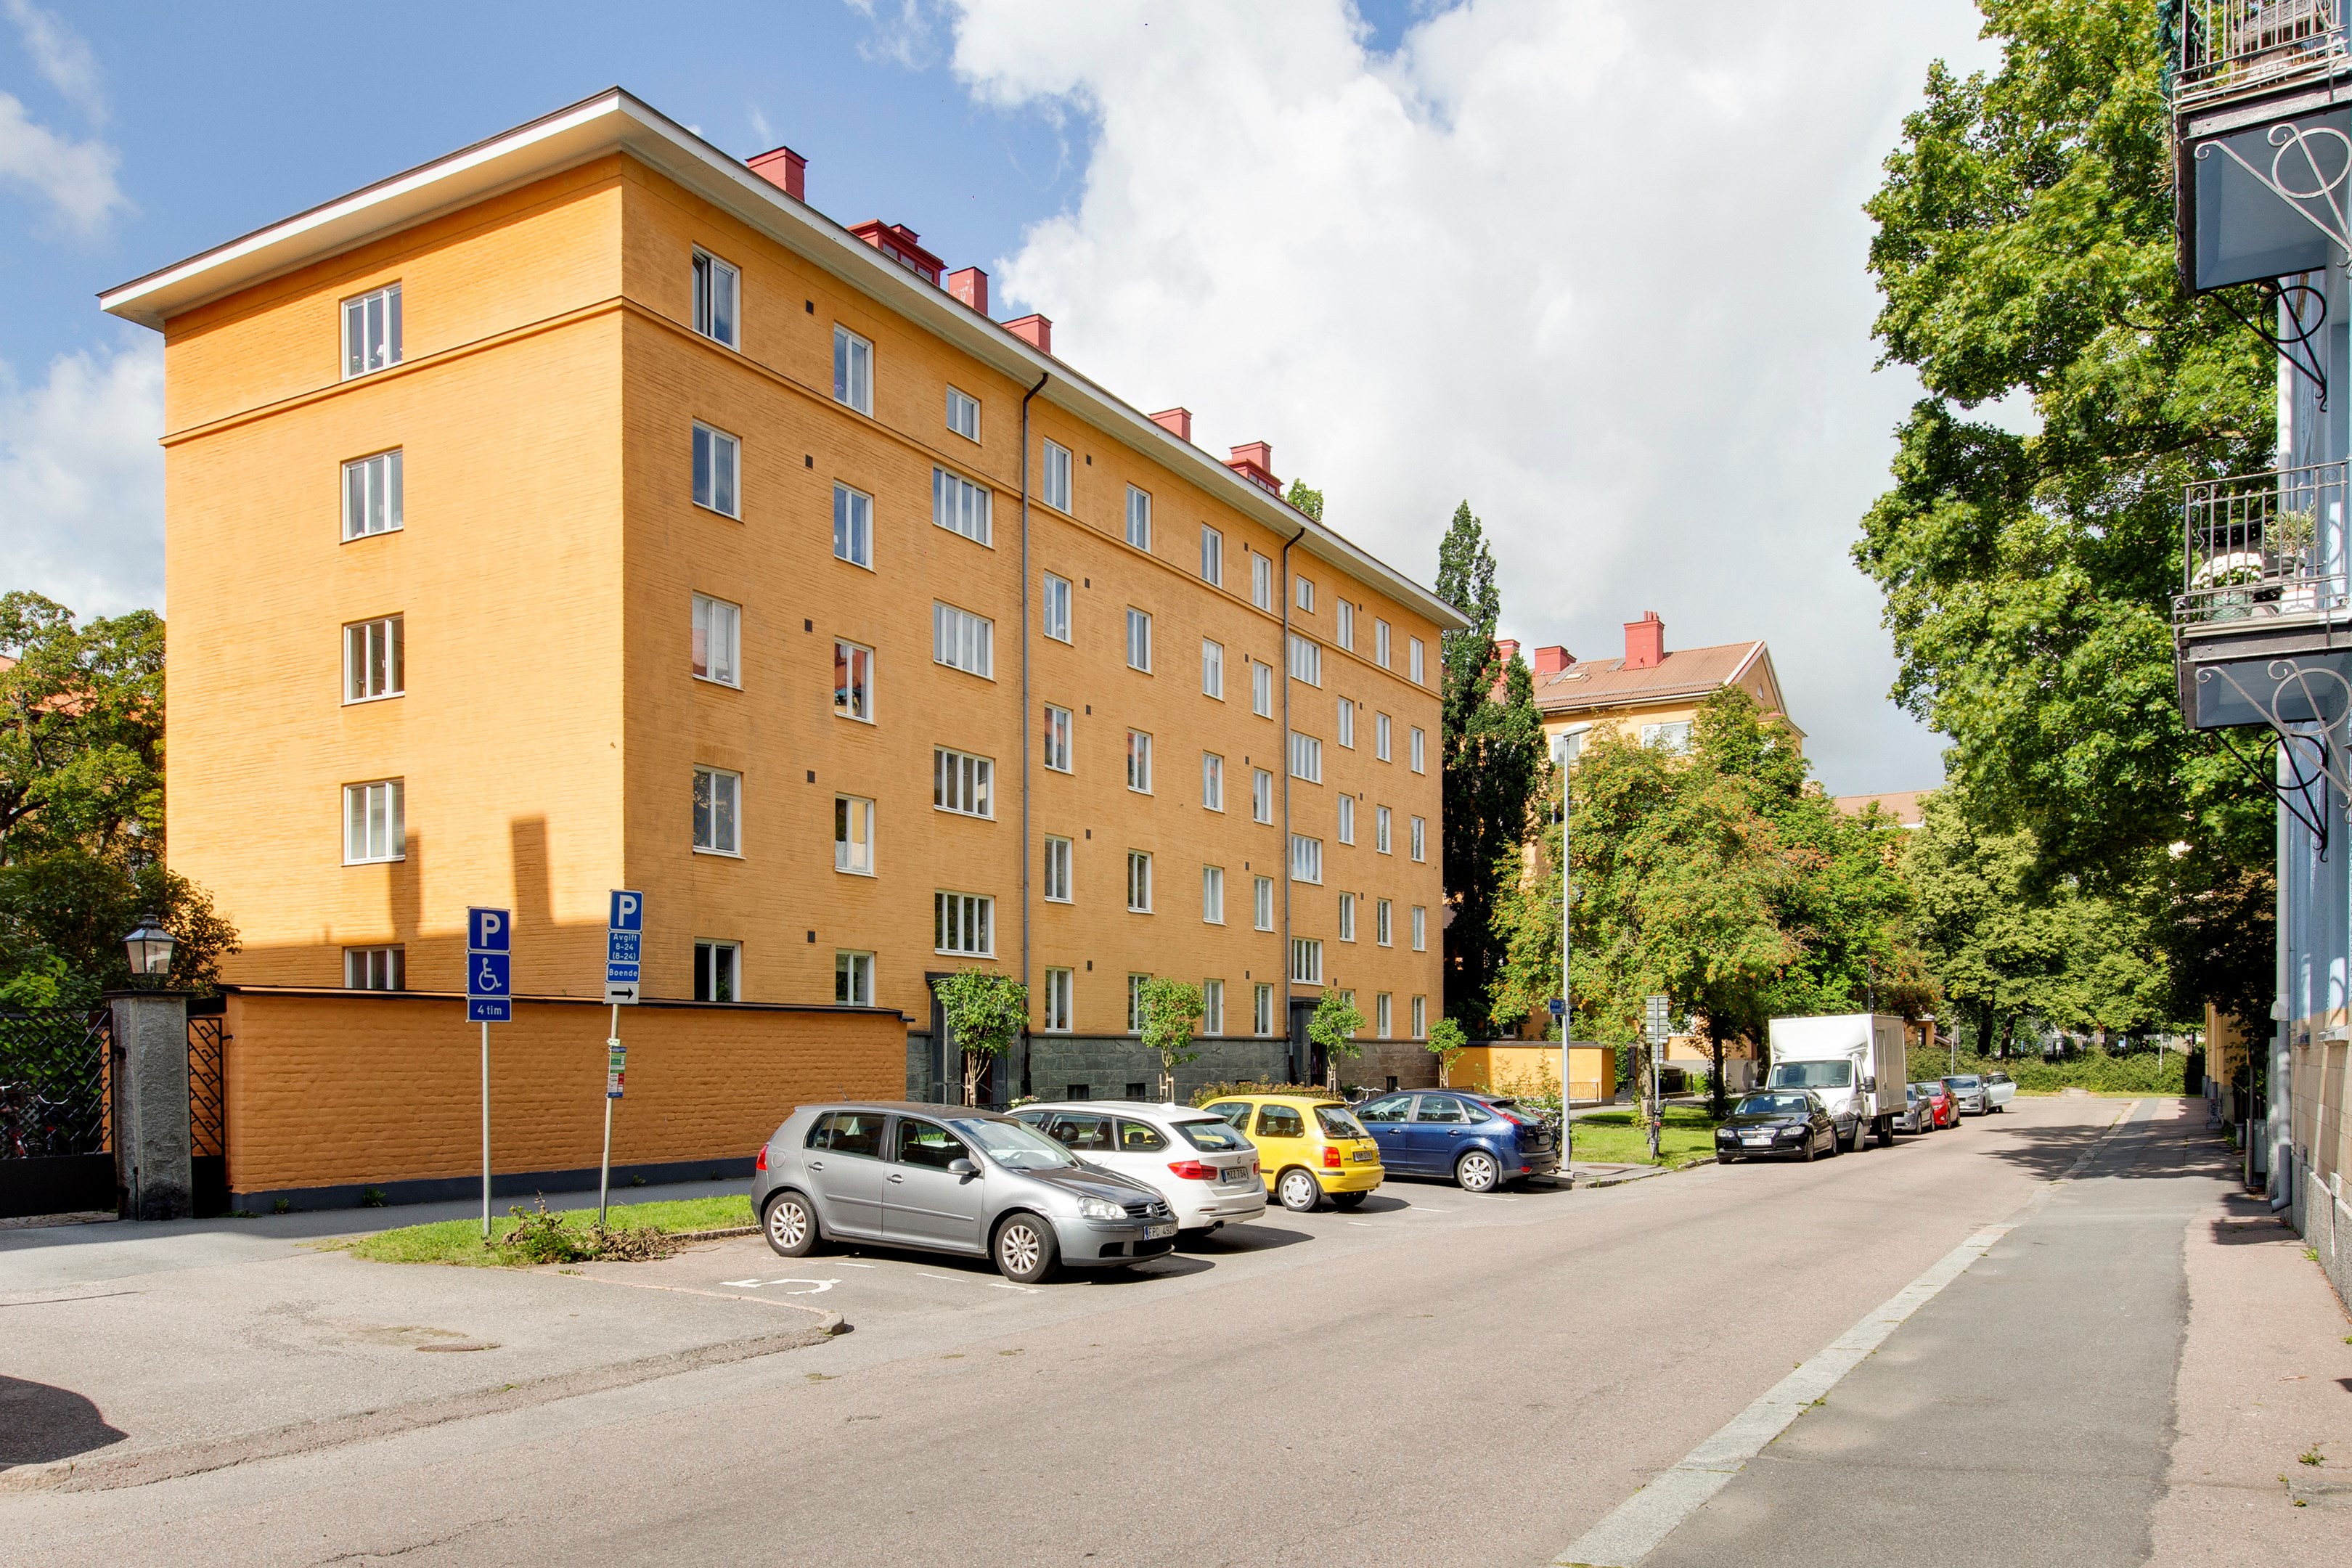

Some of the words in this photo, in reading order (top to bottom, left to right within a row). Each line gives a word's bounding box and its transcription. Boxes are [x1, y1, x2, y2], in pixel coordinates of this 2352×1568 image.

[618, 894, 637, 926] P
[481, 912, 501, 947] P
[613, 934, 637, 942] Avgift
[612, 952, 636, 960] (8-24)
[608, 968, 638, 977] Boende
[477, 1005, 485, 1015] 4
[486, 1005, 502, 1015] tim
